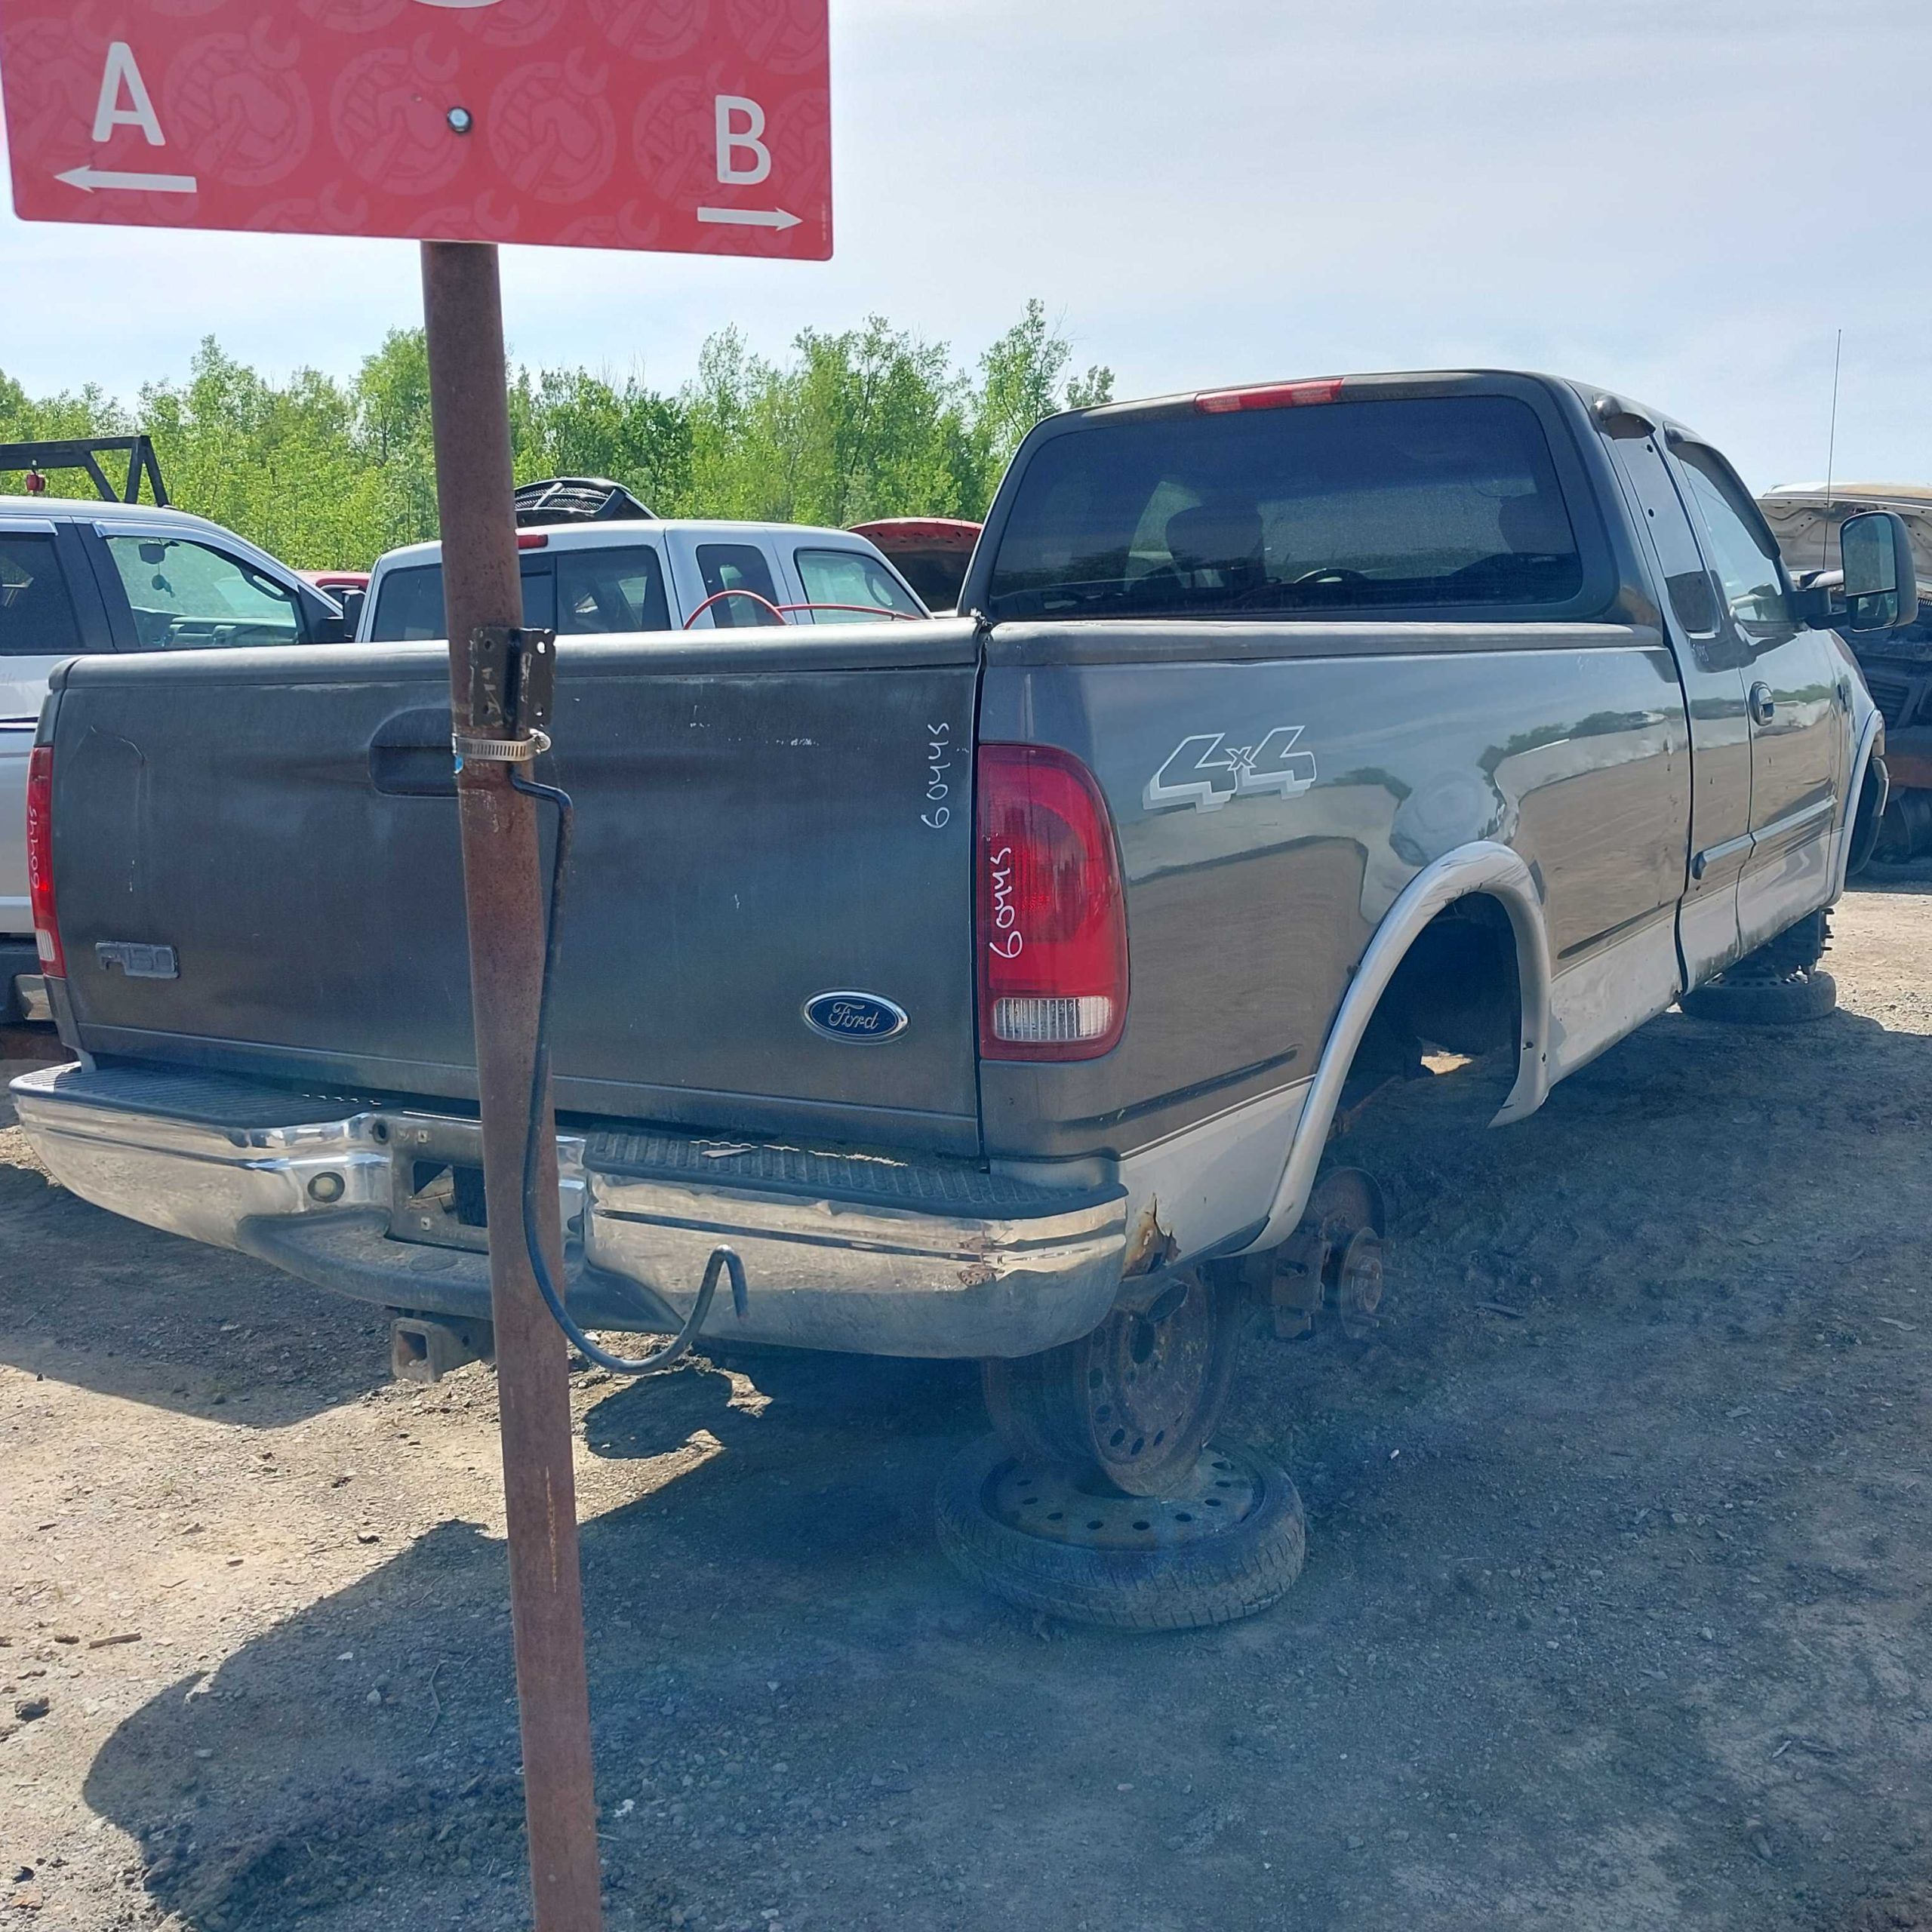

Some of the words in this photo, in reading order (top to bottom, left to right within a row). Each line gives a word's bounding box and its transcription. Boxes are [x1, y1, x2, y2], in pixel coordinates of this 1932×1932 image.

[92, 41, 166, 146] A
[715, 94, 771, 185] B
[828, 1001, 880, 1030] Ford
